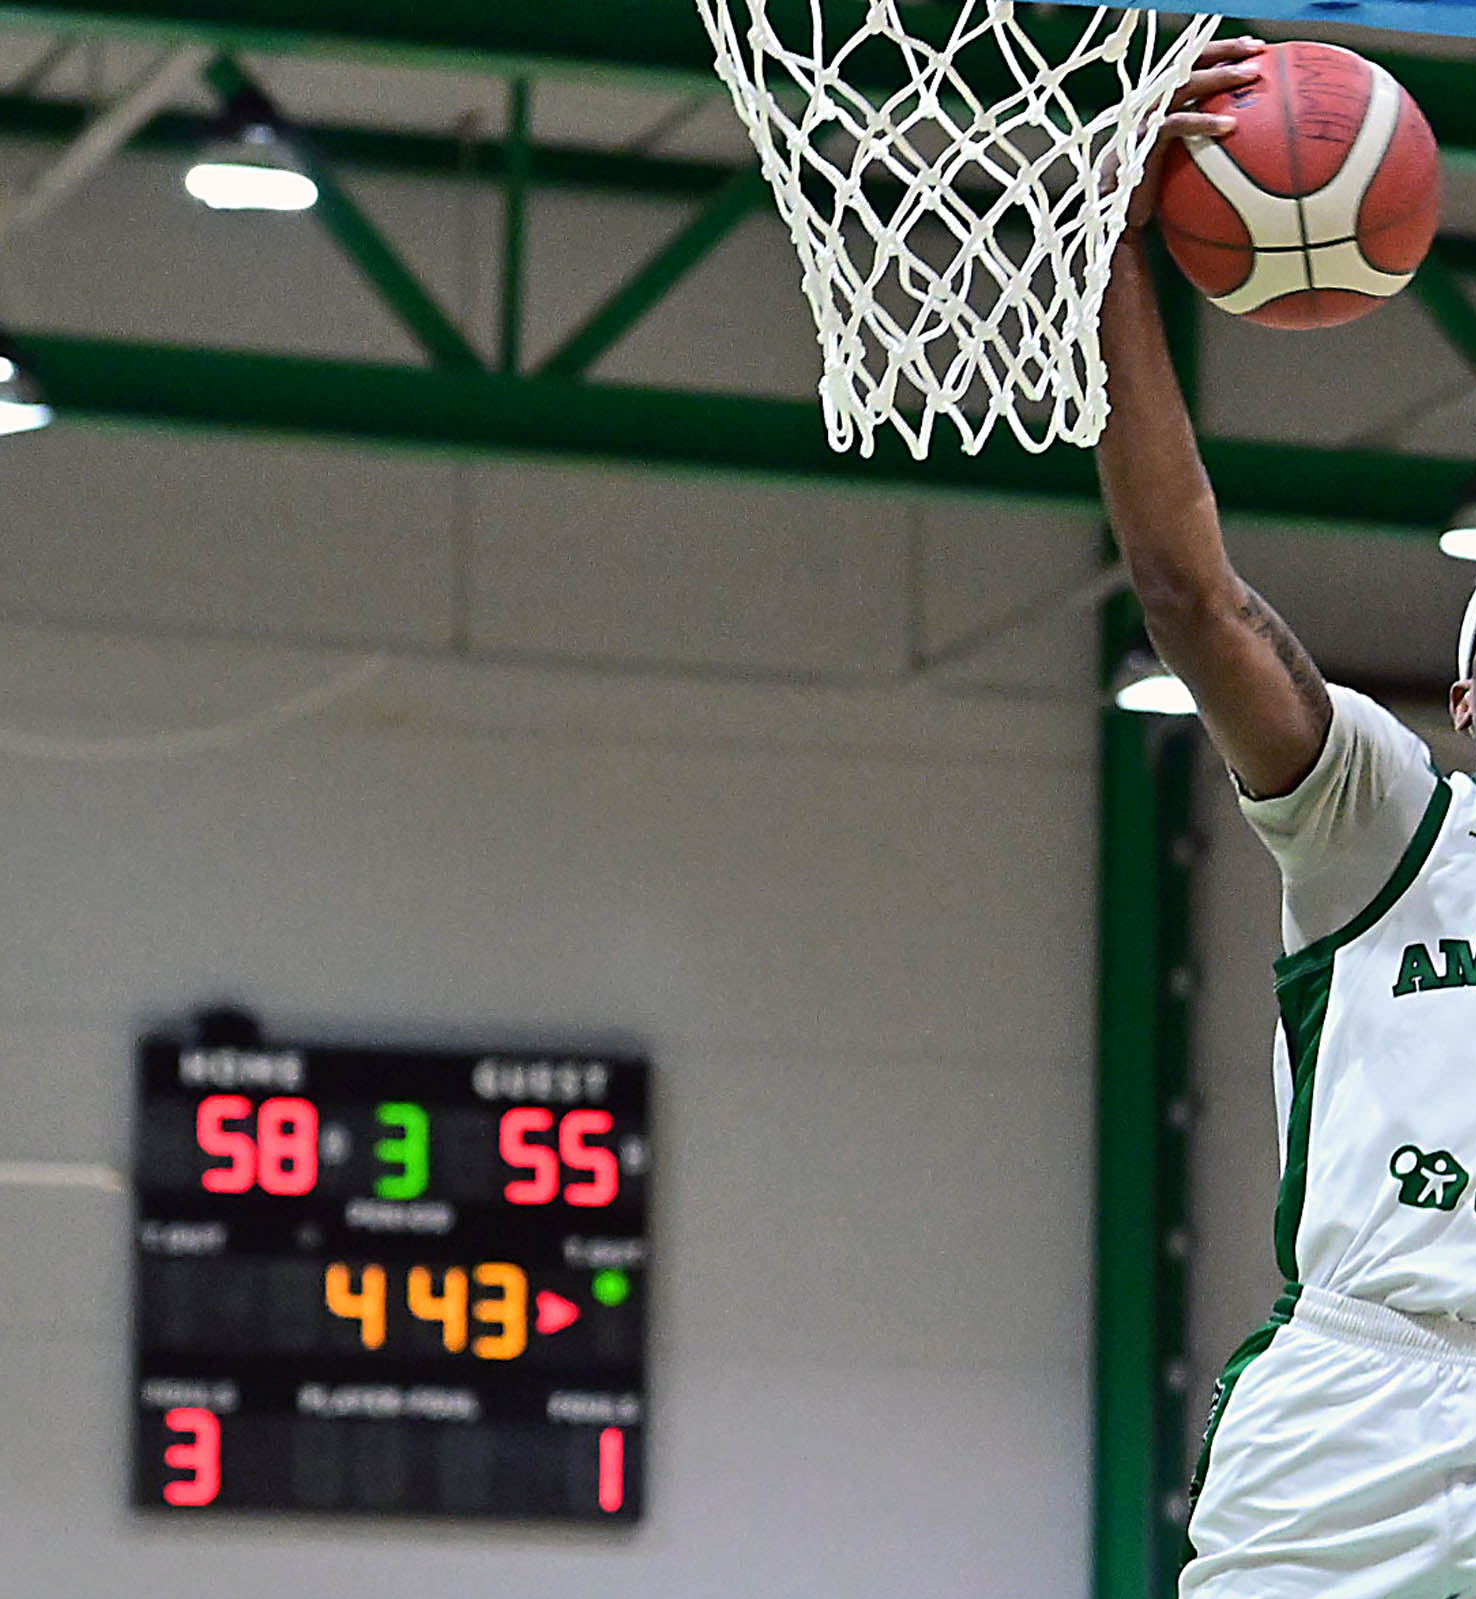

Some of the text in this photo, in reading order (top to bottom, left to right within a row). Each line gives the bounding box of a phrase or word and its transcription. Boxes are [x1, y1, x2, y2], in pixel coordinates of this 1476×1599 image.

[197, 1095, 318, 1196] 58
[374, 1102, 430, 1199] 3
[499, 1107, 618, 1207] 55
[325, 1262, 528, 1360] 4 43
[164, 1407, 221, 1507] 3
[599, 1426, 624, 1513] 1
